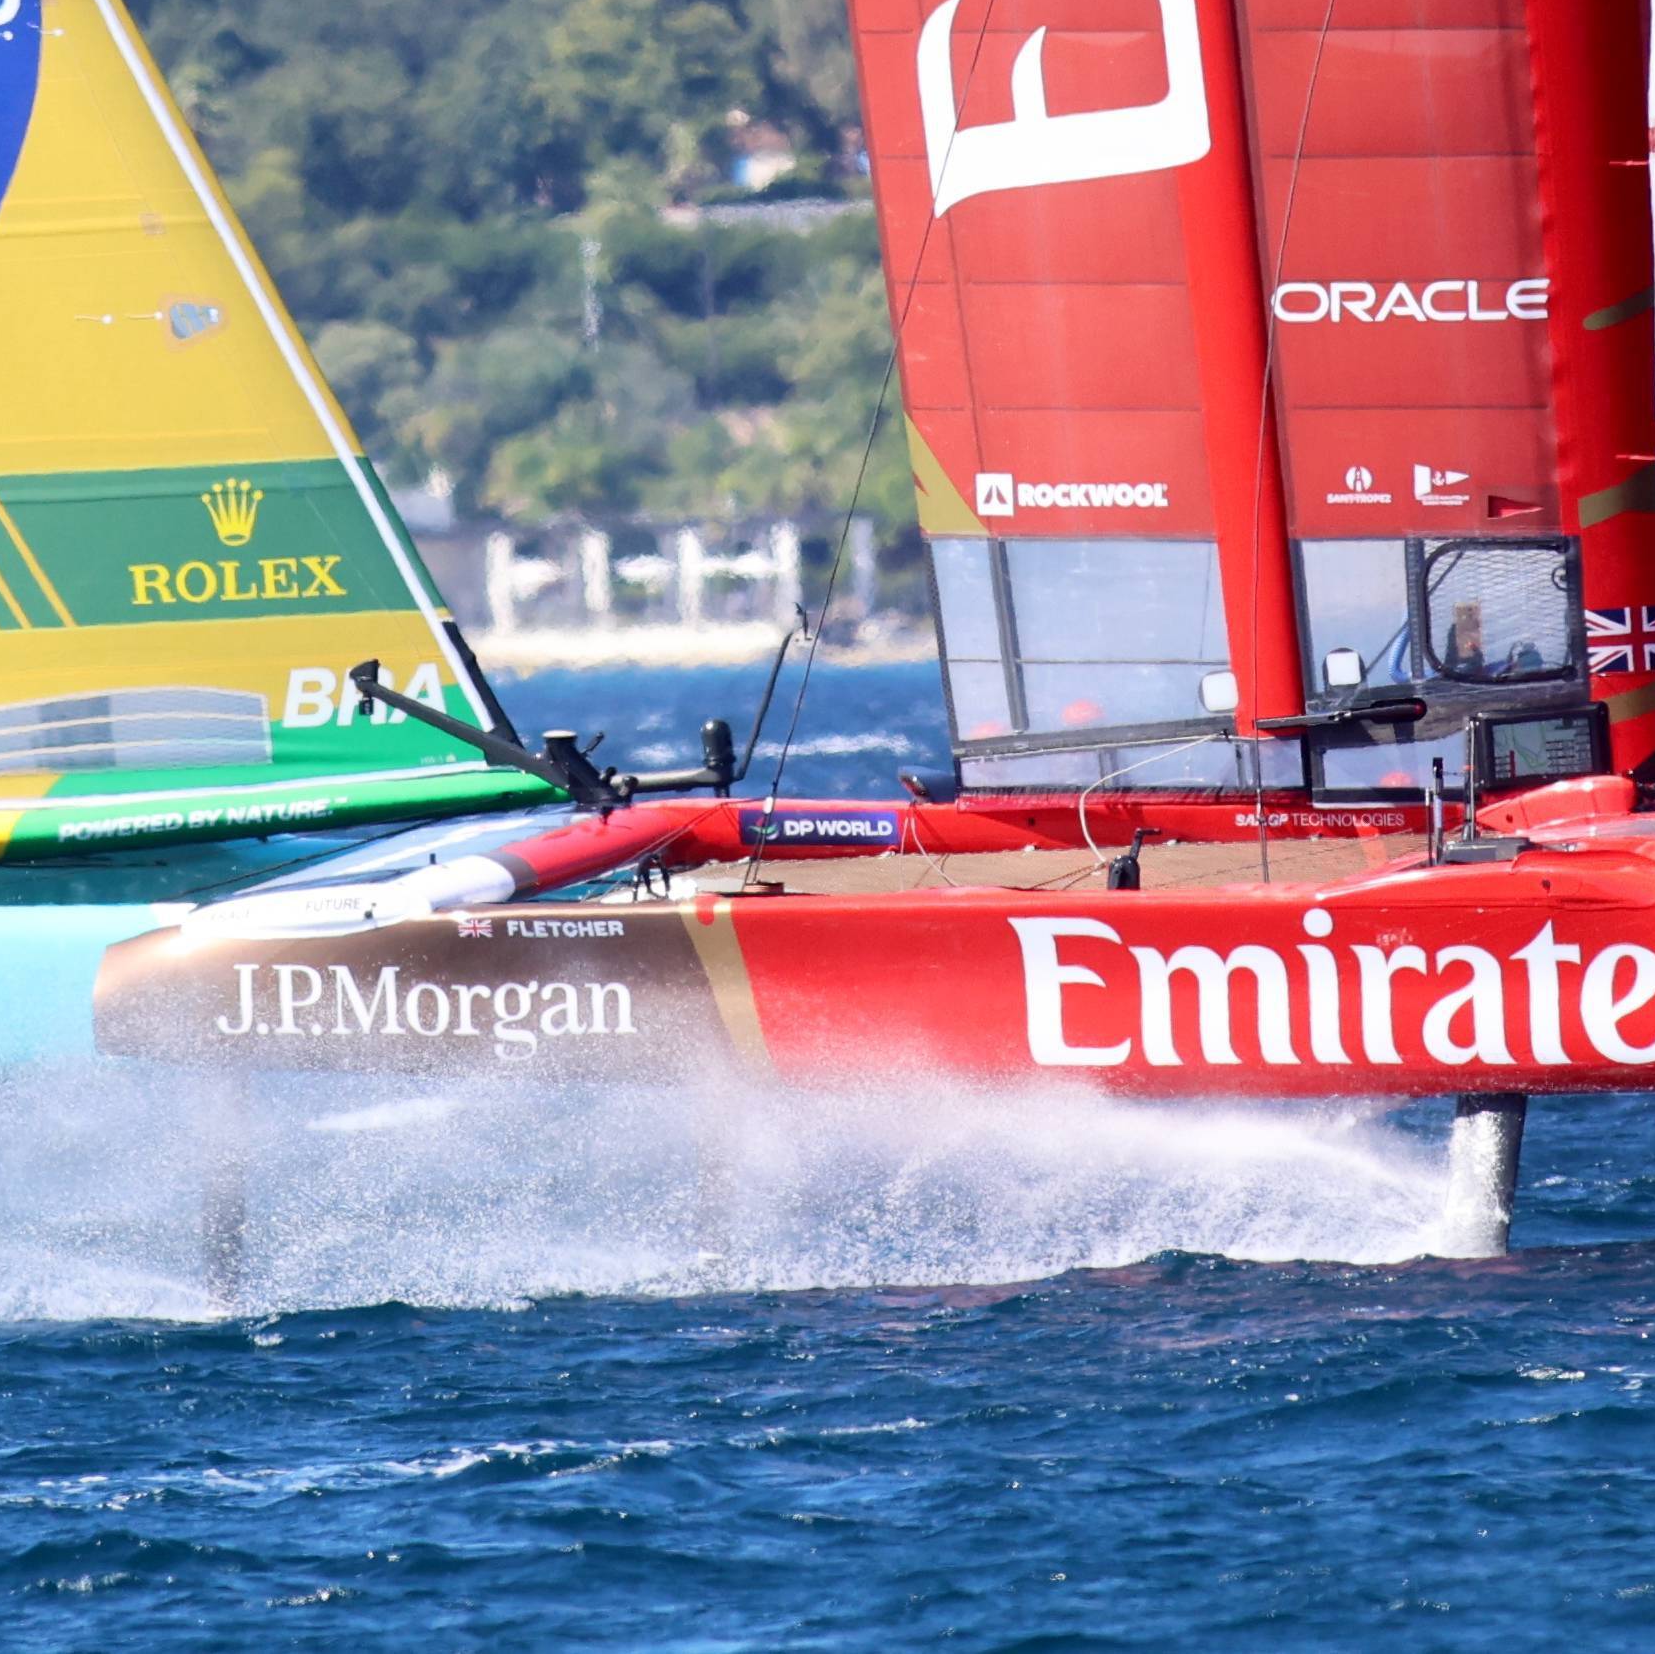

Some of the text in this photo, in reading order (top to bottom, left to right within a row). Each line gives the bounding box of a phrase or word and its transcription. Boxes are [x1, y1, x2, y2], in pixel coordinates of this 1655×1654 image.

[1271, 278, 1551, 323] ORACLE
[1017, 482, 1169, 508] ROCKWOOL
[128, 554, 348, 606] ROLEX
[281, 661, 449, 729] BRA
[58, 811, 184, 843] POWERED
[188, 808, 224, 829] BY
[783, 819, 894, 837] DP WORLD
[1291, 812, 1405, 827] TECHNOLOGIES
[506, 919, 625, 939] FLETCHER
